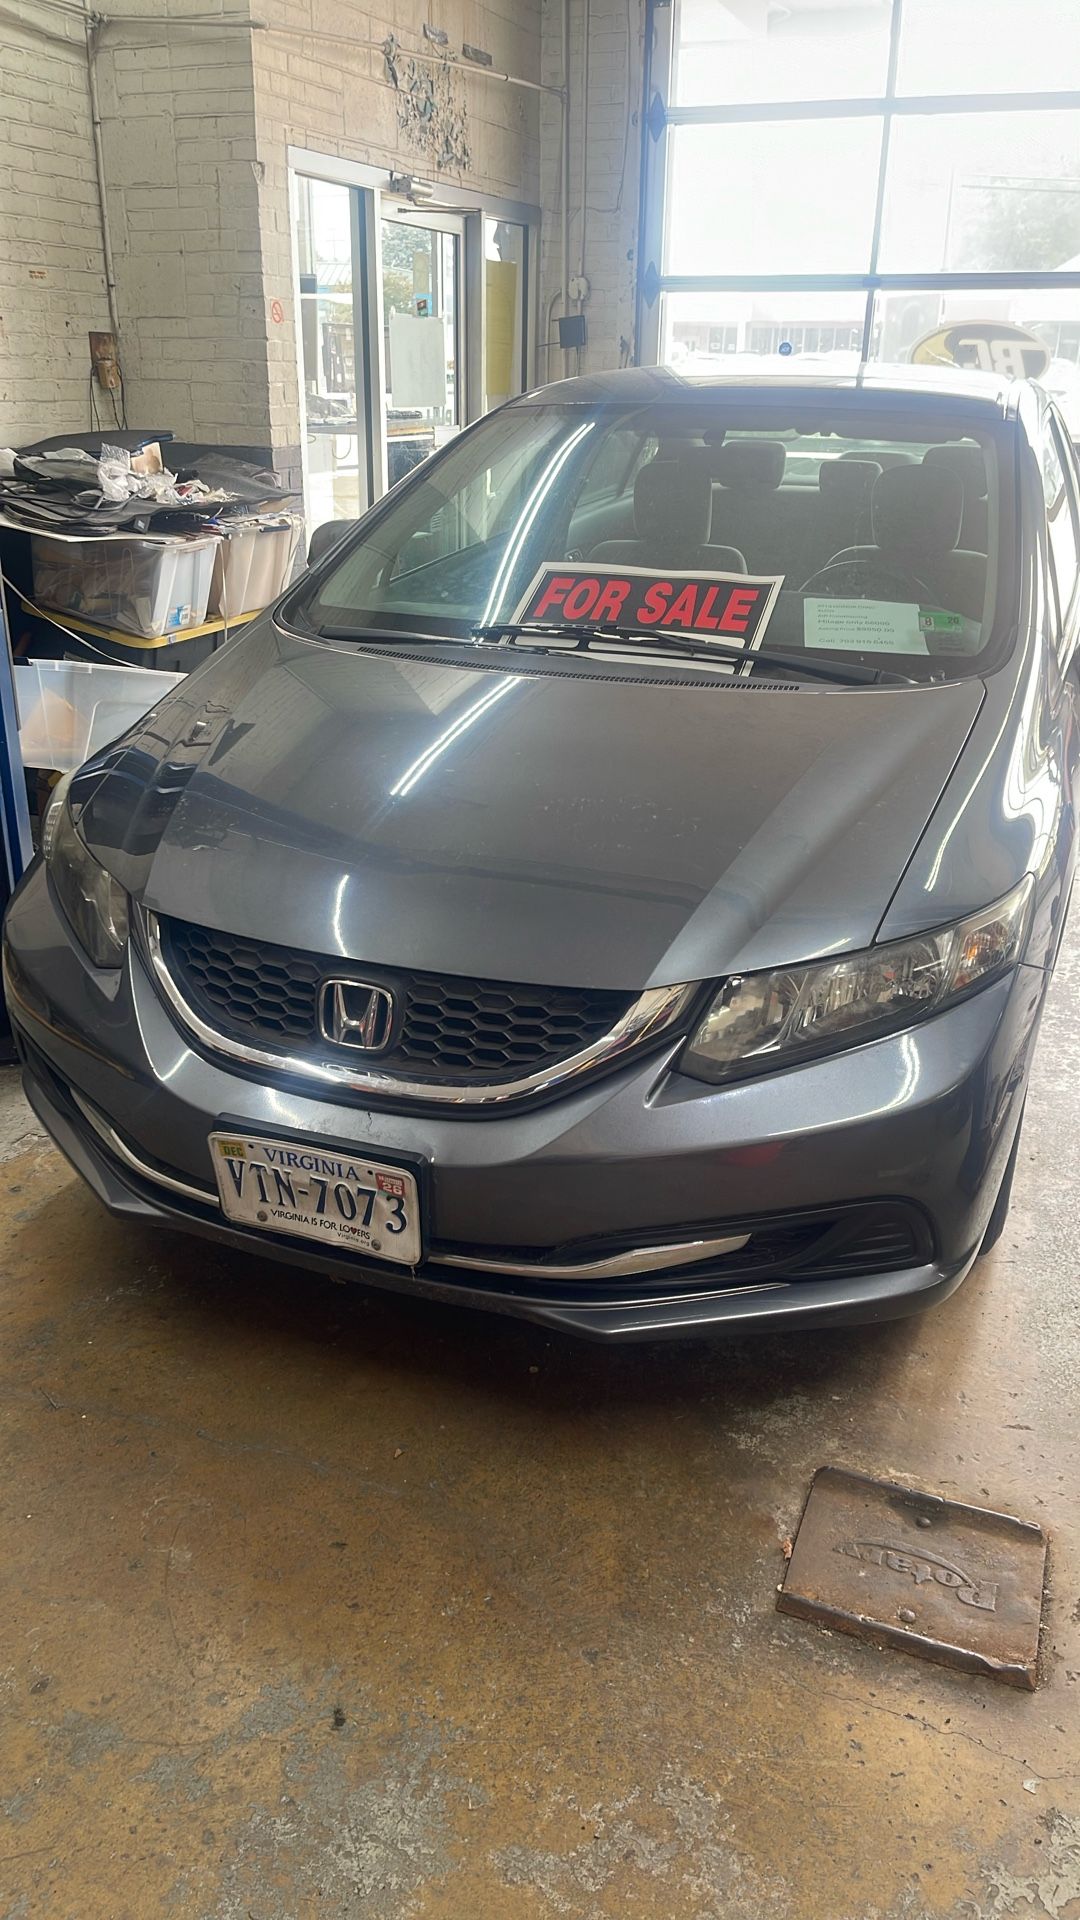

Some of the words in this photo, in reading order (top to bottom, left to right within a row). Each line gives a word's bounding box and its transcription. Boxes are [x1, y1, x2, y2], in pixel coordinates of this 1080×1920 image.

[532, 576, 631, 622] FOR
[636, 582, 760, 633] SALE
[223, 1145, 244, 1157] DEC
[263, 1148, 361, 1182] VIRGINIA
[224, 1158, 408, 1235] VTN-7073
[382, 1182, 403, 1196] 26
[270, 1209, 310, 1225] VIRGINIA
[311, 1217, 318, 1226] IS
[320, 1219, 337, 1232] FOR
